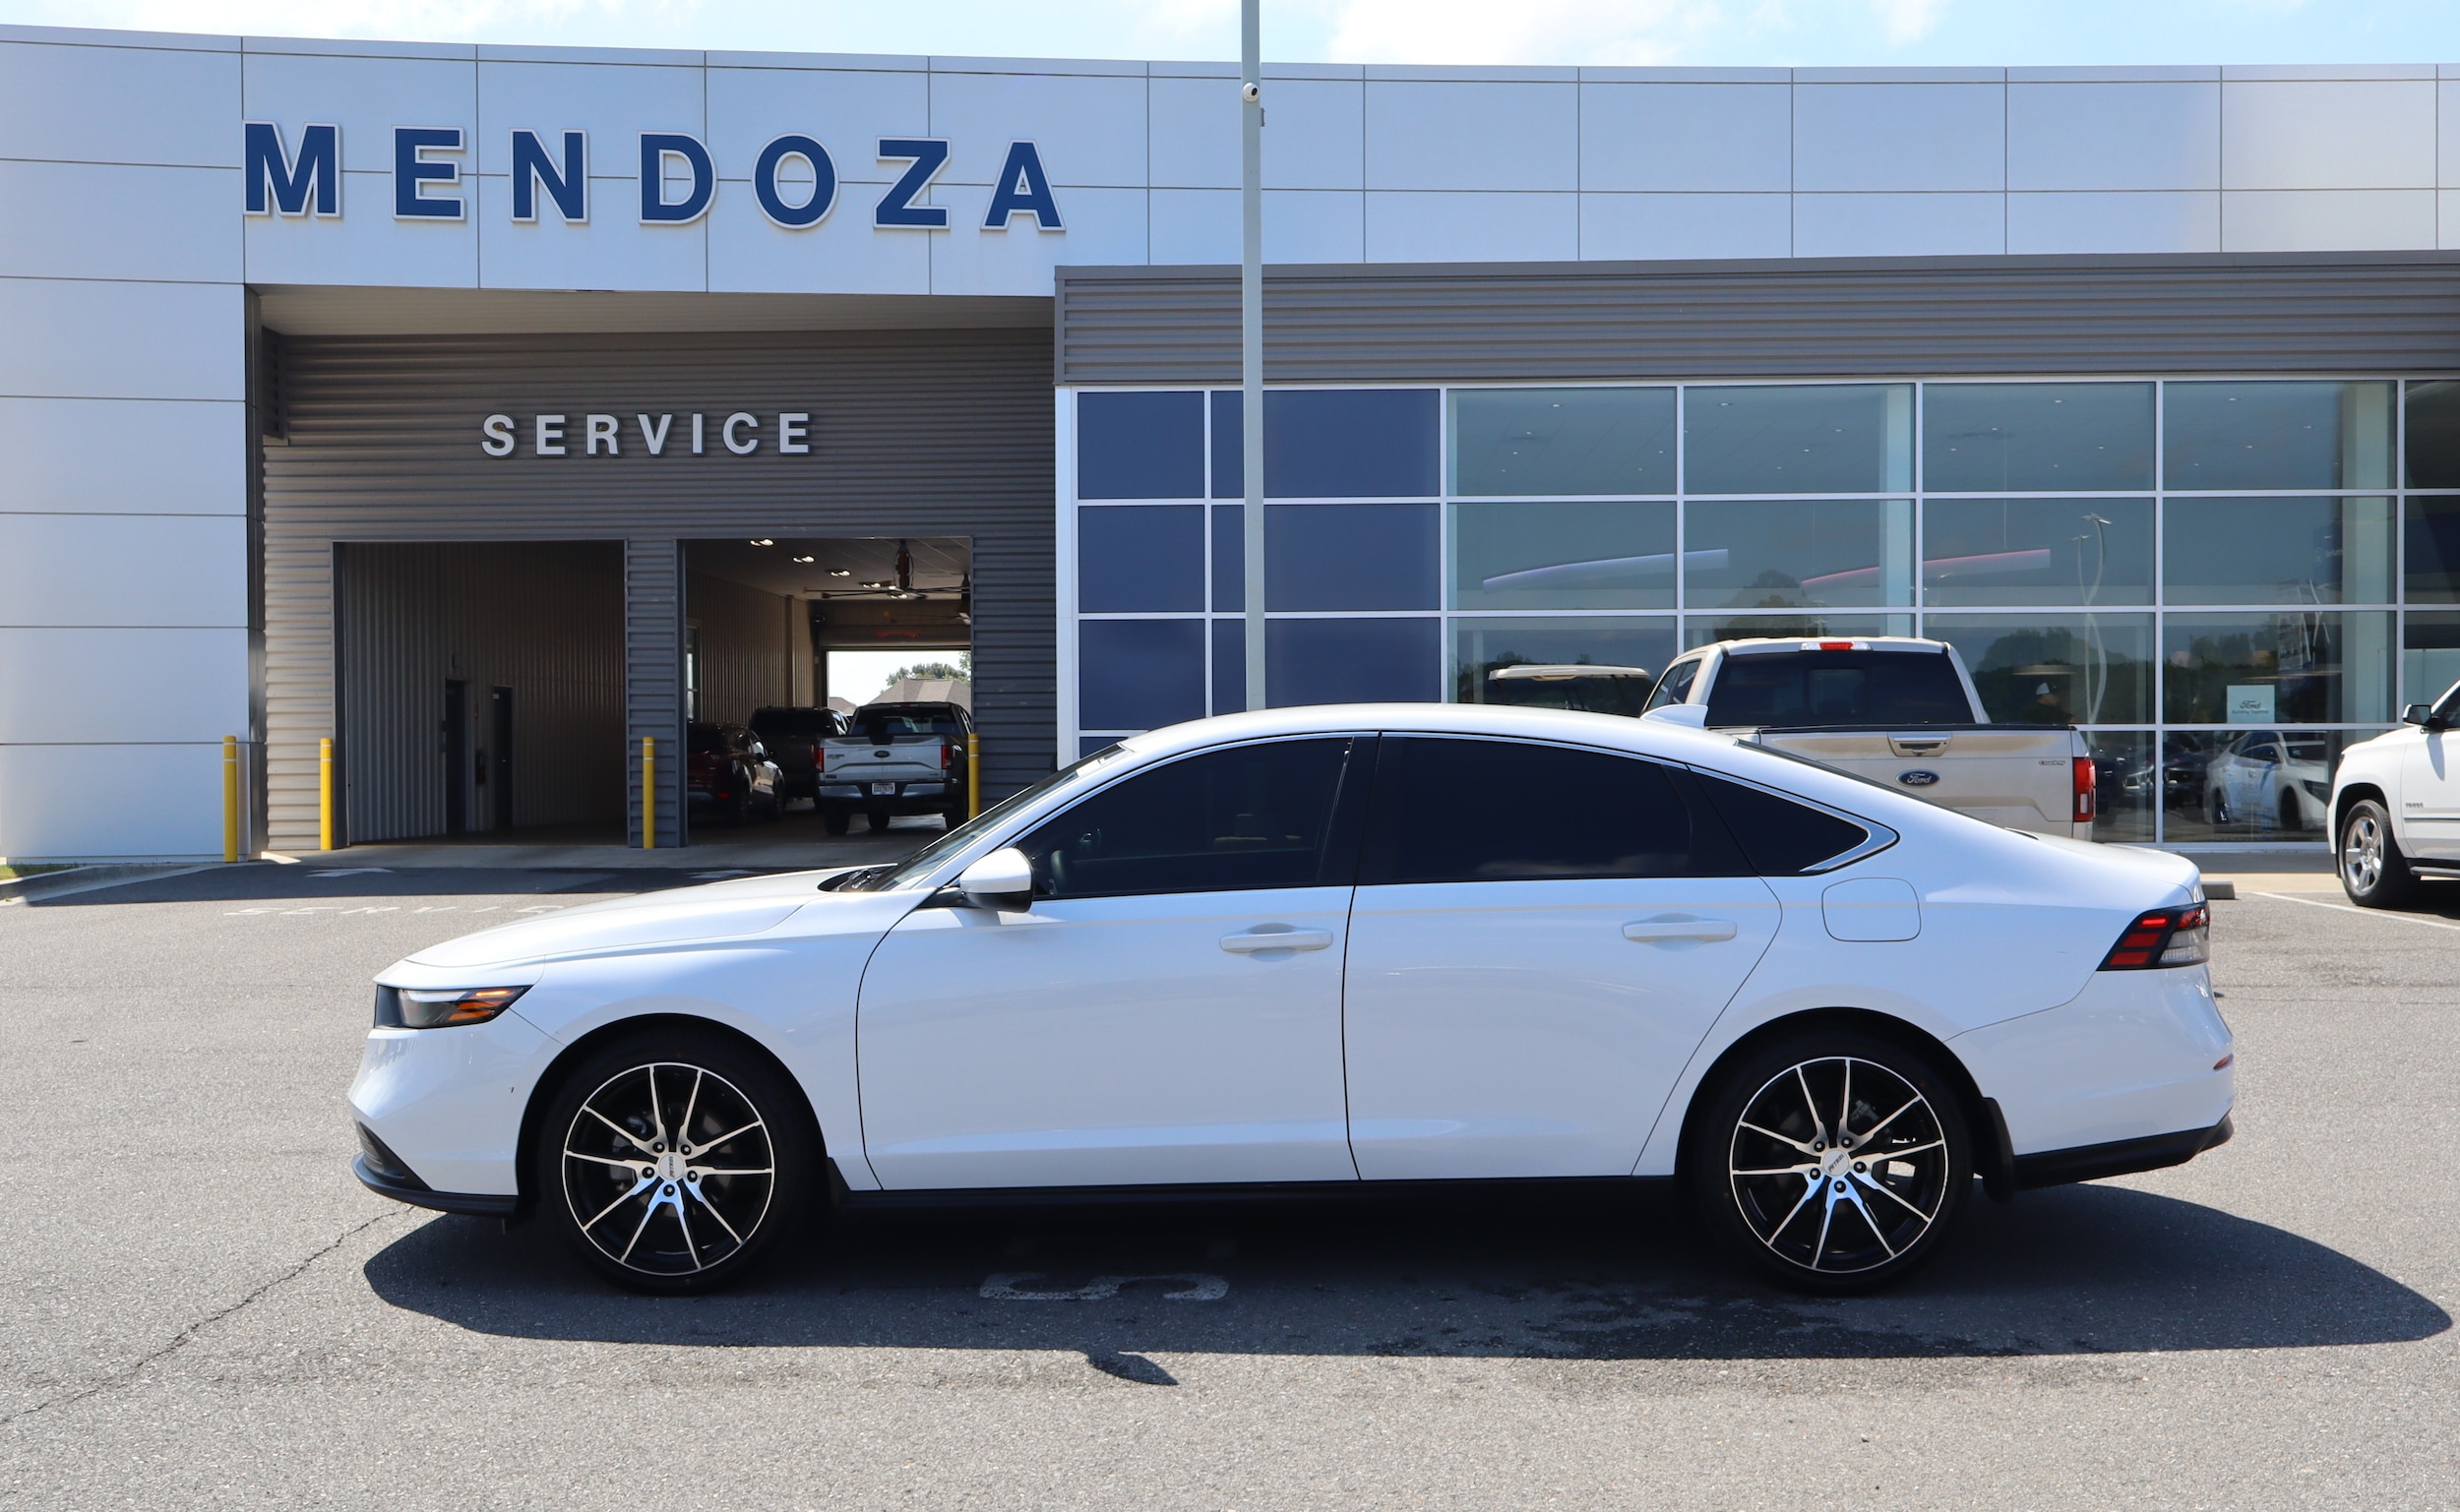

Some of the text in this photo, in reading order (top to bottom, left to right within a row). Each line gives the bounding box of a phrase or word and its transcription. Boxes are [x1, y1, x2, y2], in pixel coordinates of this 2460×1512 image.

[242, 120, 1067, 232] MENDOZA
[481, 410, 814, 458] SERVICE
[2240, 699, 2262, 709] Ford
[1907, 773, 1933, 784] Ford
[223, 905, 566, 916] SERVIC
